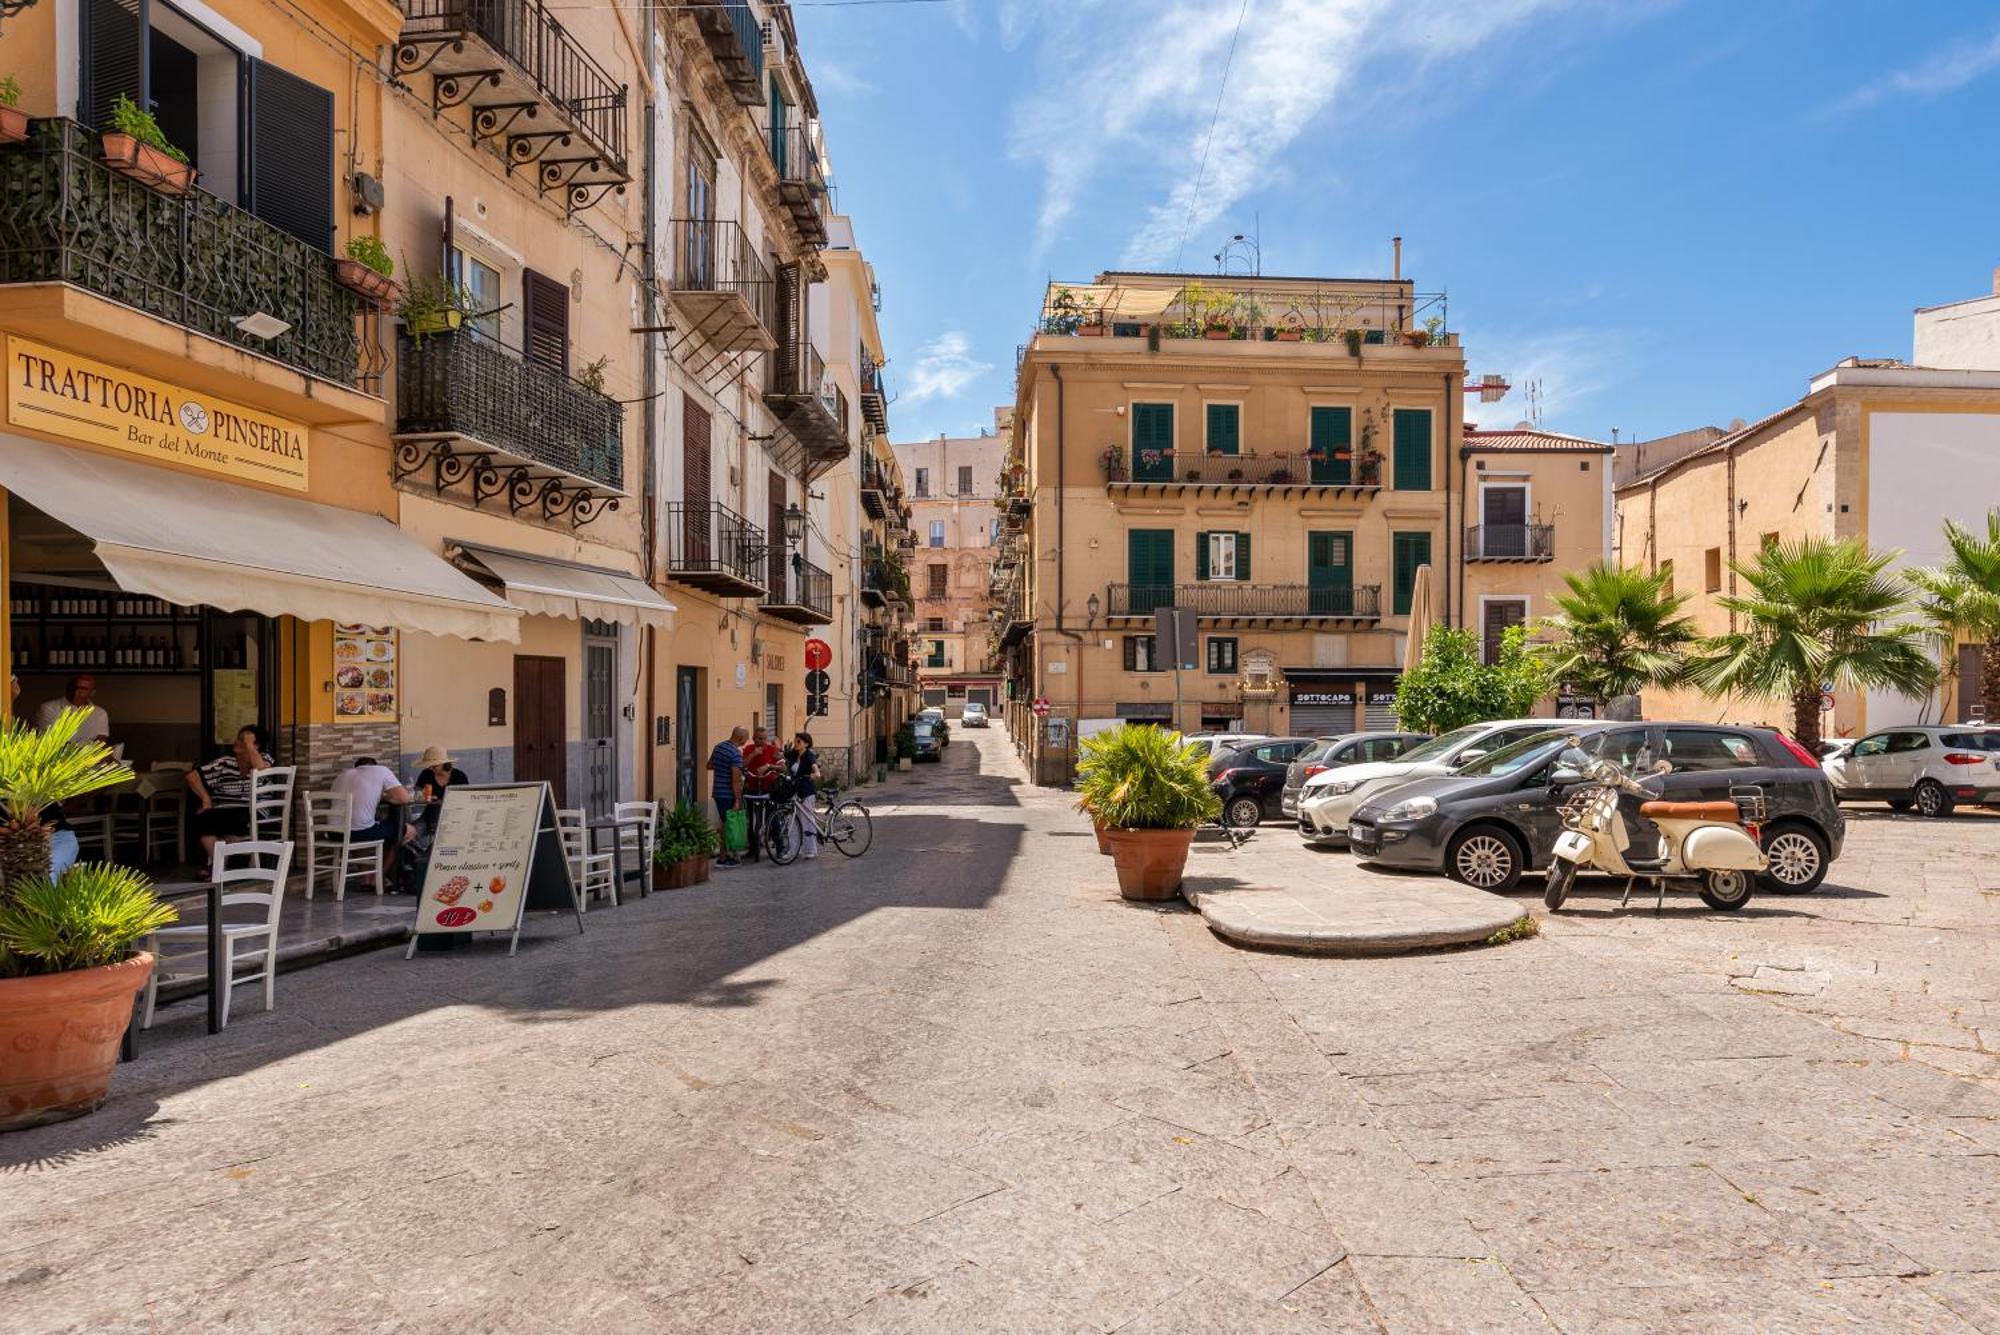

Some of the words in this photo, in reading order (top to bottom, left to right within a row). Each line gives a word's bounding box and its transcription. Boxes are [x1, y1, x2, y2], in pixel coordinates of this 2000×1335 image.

[18, 353, 175, 426] TRATTORIA
[212, 410, 304, 461] PINSERIA
[127, 424, 154, 445] Bar
[159, 434, 180, 452] del
[184, 440, 229, 465] Monte
